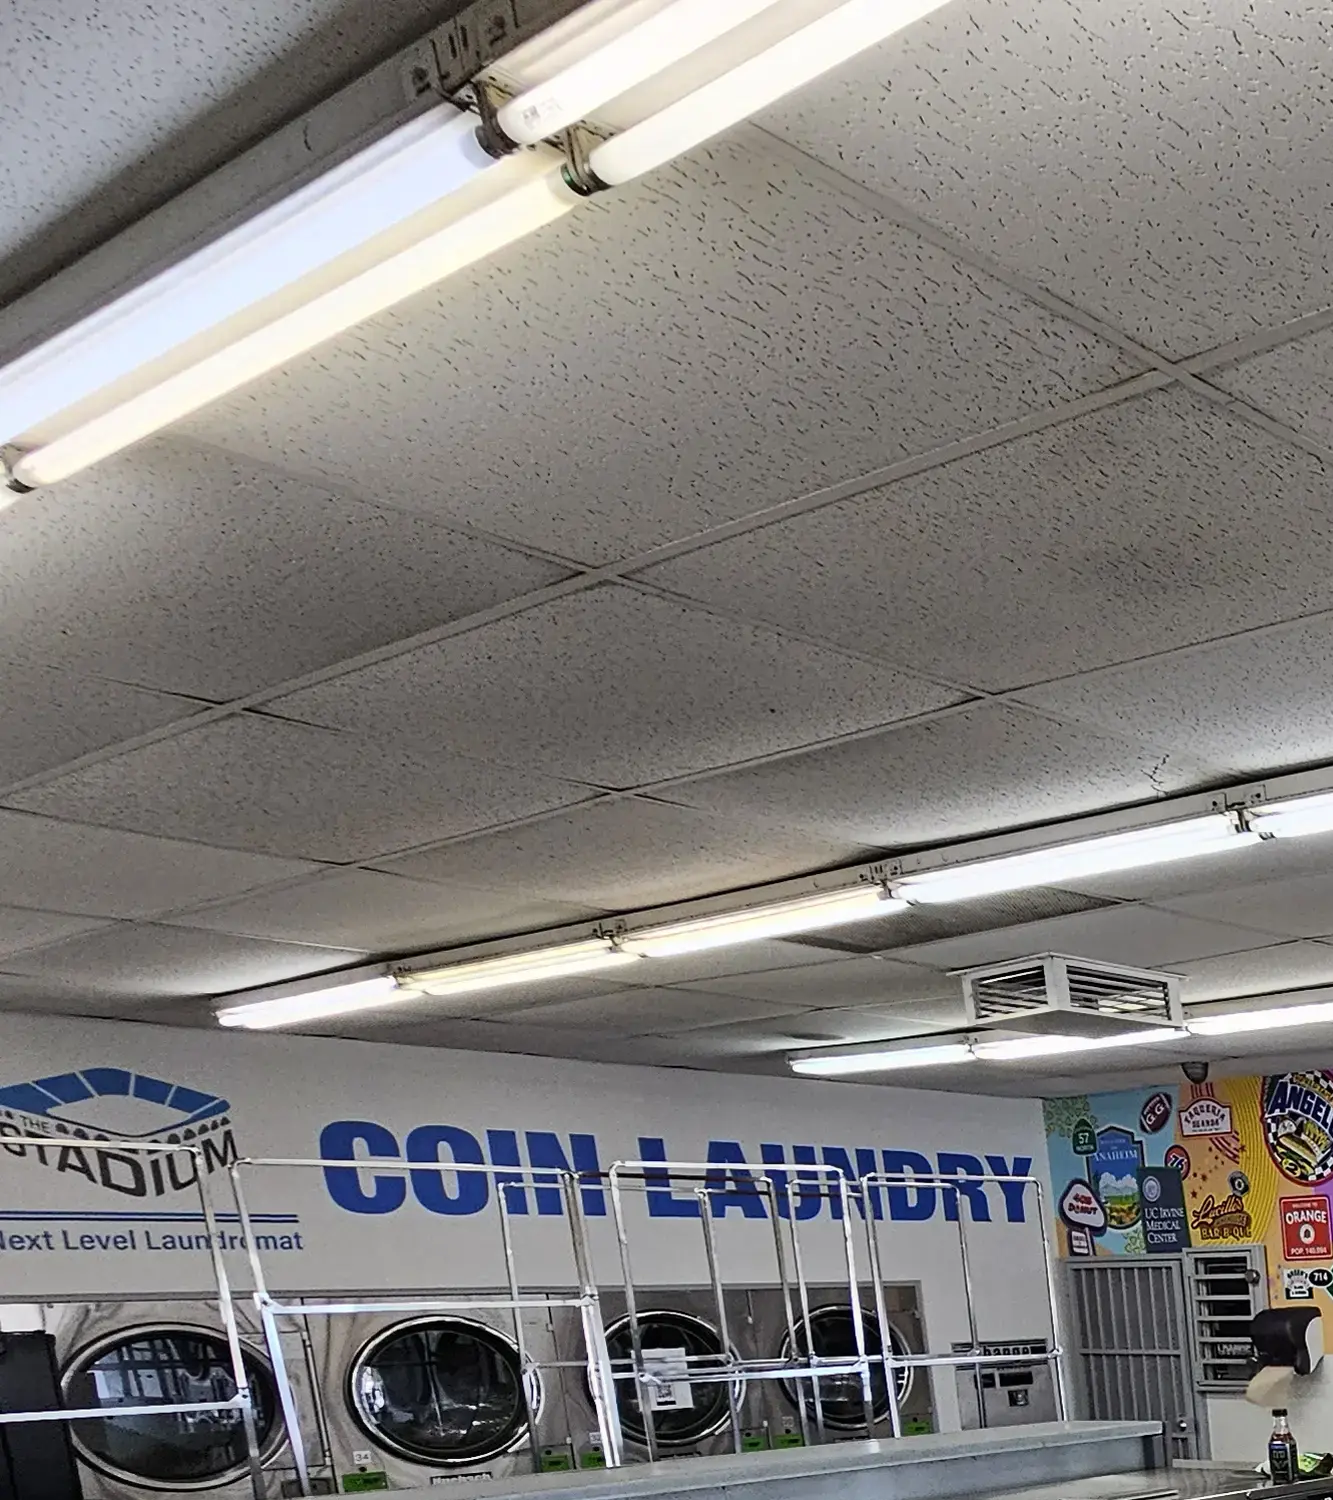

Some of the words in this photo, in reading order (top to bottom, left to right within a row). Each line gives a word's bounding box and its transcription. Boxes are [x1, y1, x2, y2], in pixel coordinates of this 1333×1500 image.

[22, 1115, 50, 1132] THE
[1078, 1132, 1090, 1145] 57
[0, 1121, 239, 1197] STADIUM
[1093, 1149, 1138, 1162] ANAHEIM
[1167, 1152, 1188, 1169] 76
[319, 1119, 607, 1217] COIN
[637, 1136, 1033, 1223] LAUNDRY
[1145, 1208, 1158, 1219] UC
[1160, 1207, 1185, 1218] IRVINE
[1286, 1209, 1328, 1224] ORANGE
[1146, 1220, 1181, 1231] MEDICAL
[62, 1230, 136, 1251] Level
[1147, 1232, 1178, 1244] CENTER
